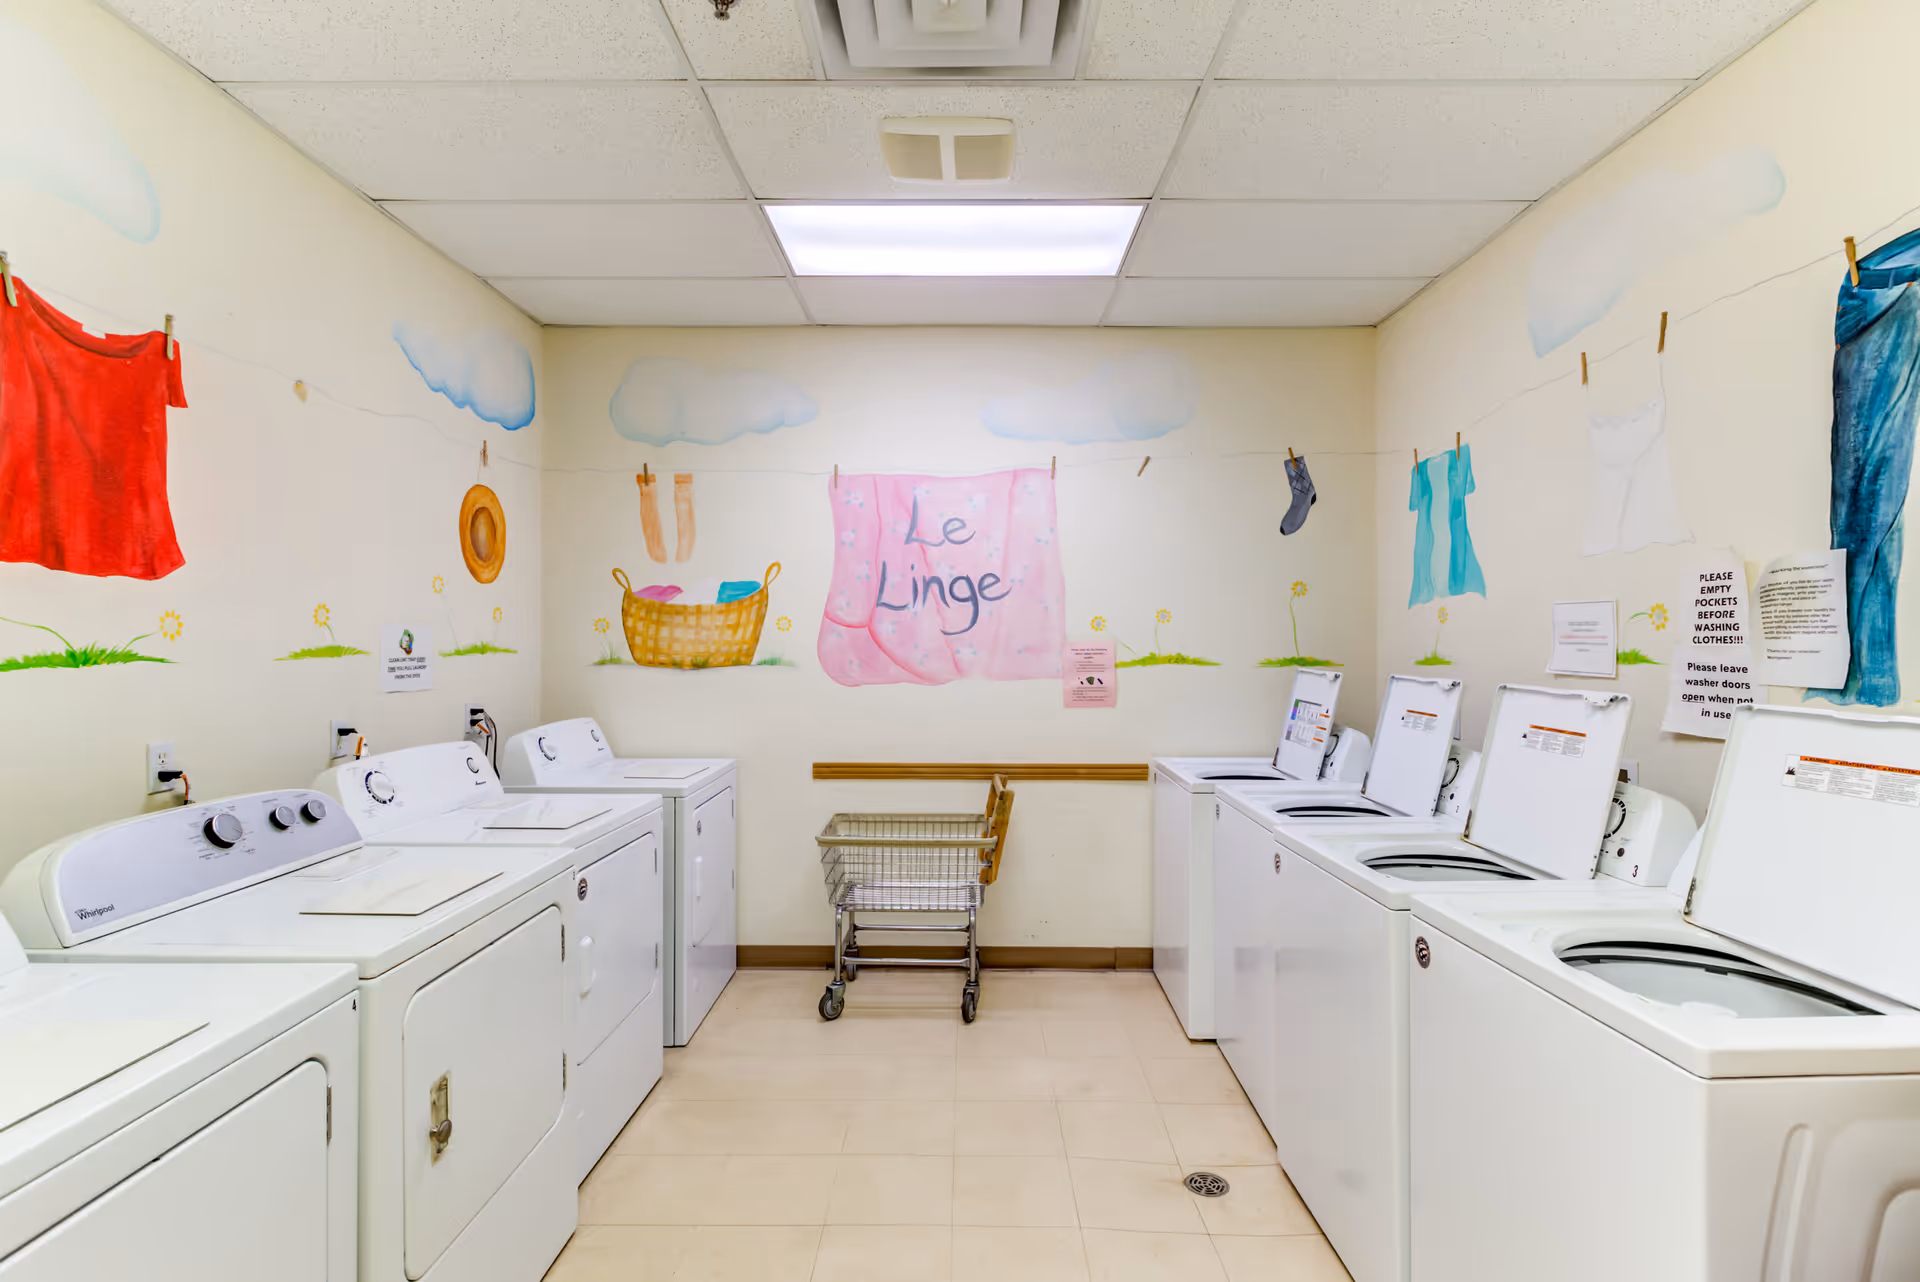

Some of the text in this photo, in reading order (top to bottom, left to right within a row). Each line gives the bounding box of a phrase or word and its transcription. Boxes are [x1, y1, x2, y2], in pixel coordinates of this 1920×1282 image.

[904, 494, 976, 547] Le
[1699, 571, 1733, 582] PLEASE
[1700, 585, 1731, 594] EMPTY
[876, 560, 1012, 635] Linge
[1695, 597, 1738, 607] POCKETS
[1697, 610, 1735, 619] BEFORE
[1694, 623, 1740, 632] WASHING
[1692, 635, 1744, 644] CLOTHES!!!
[1687, 662, 1748, 673] Please leave
[1685, 678, 1751, 689] washer doors
[1682, 693, 1705, 702] open
[1708, 694, 1734, 704] when
[1701, 708, 1731, 719] in use
[1632, 864, 1639, 878] 3
[77, 904, 115, 920] Whirlpool
